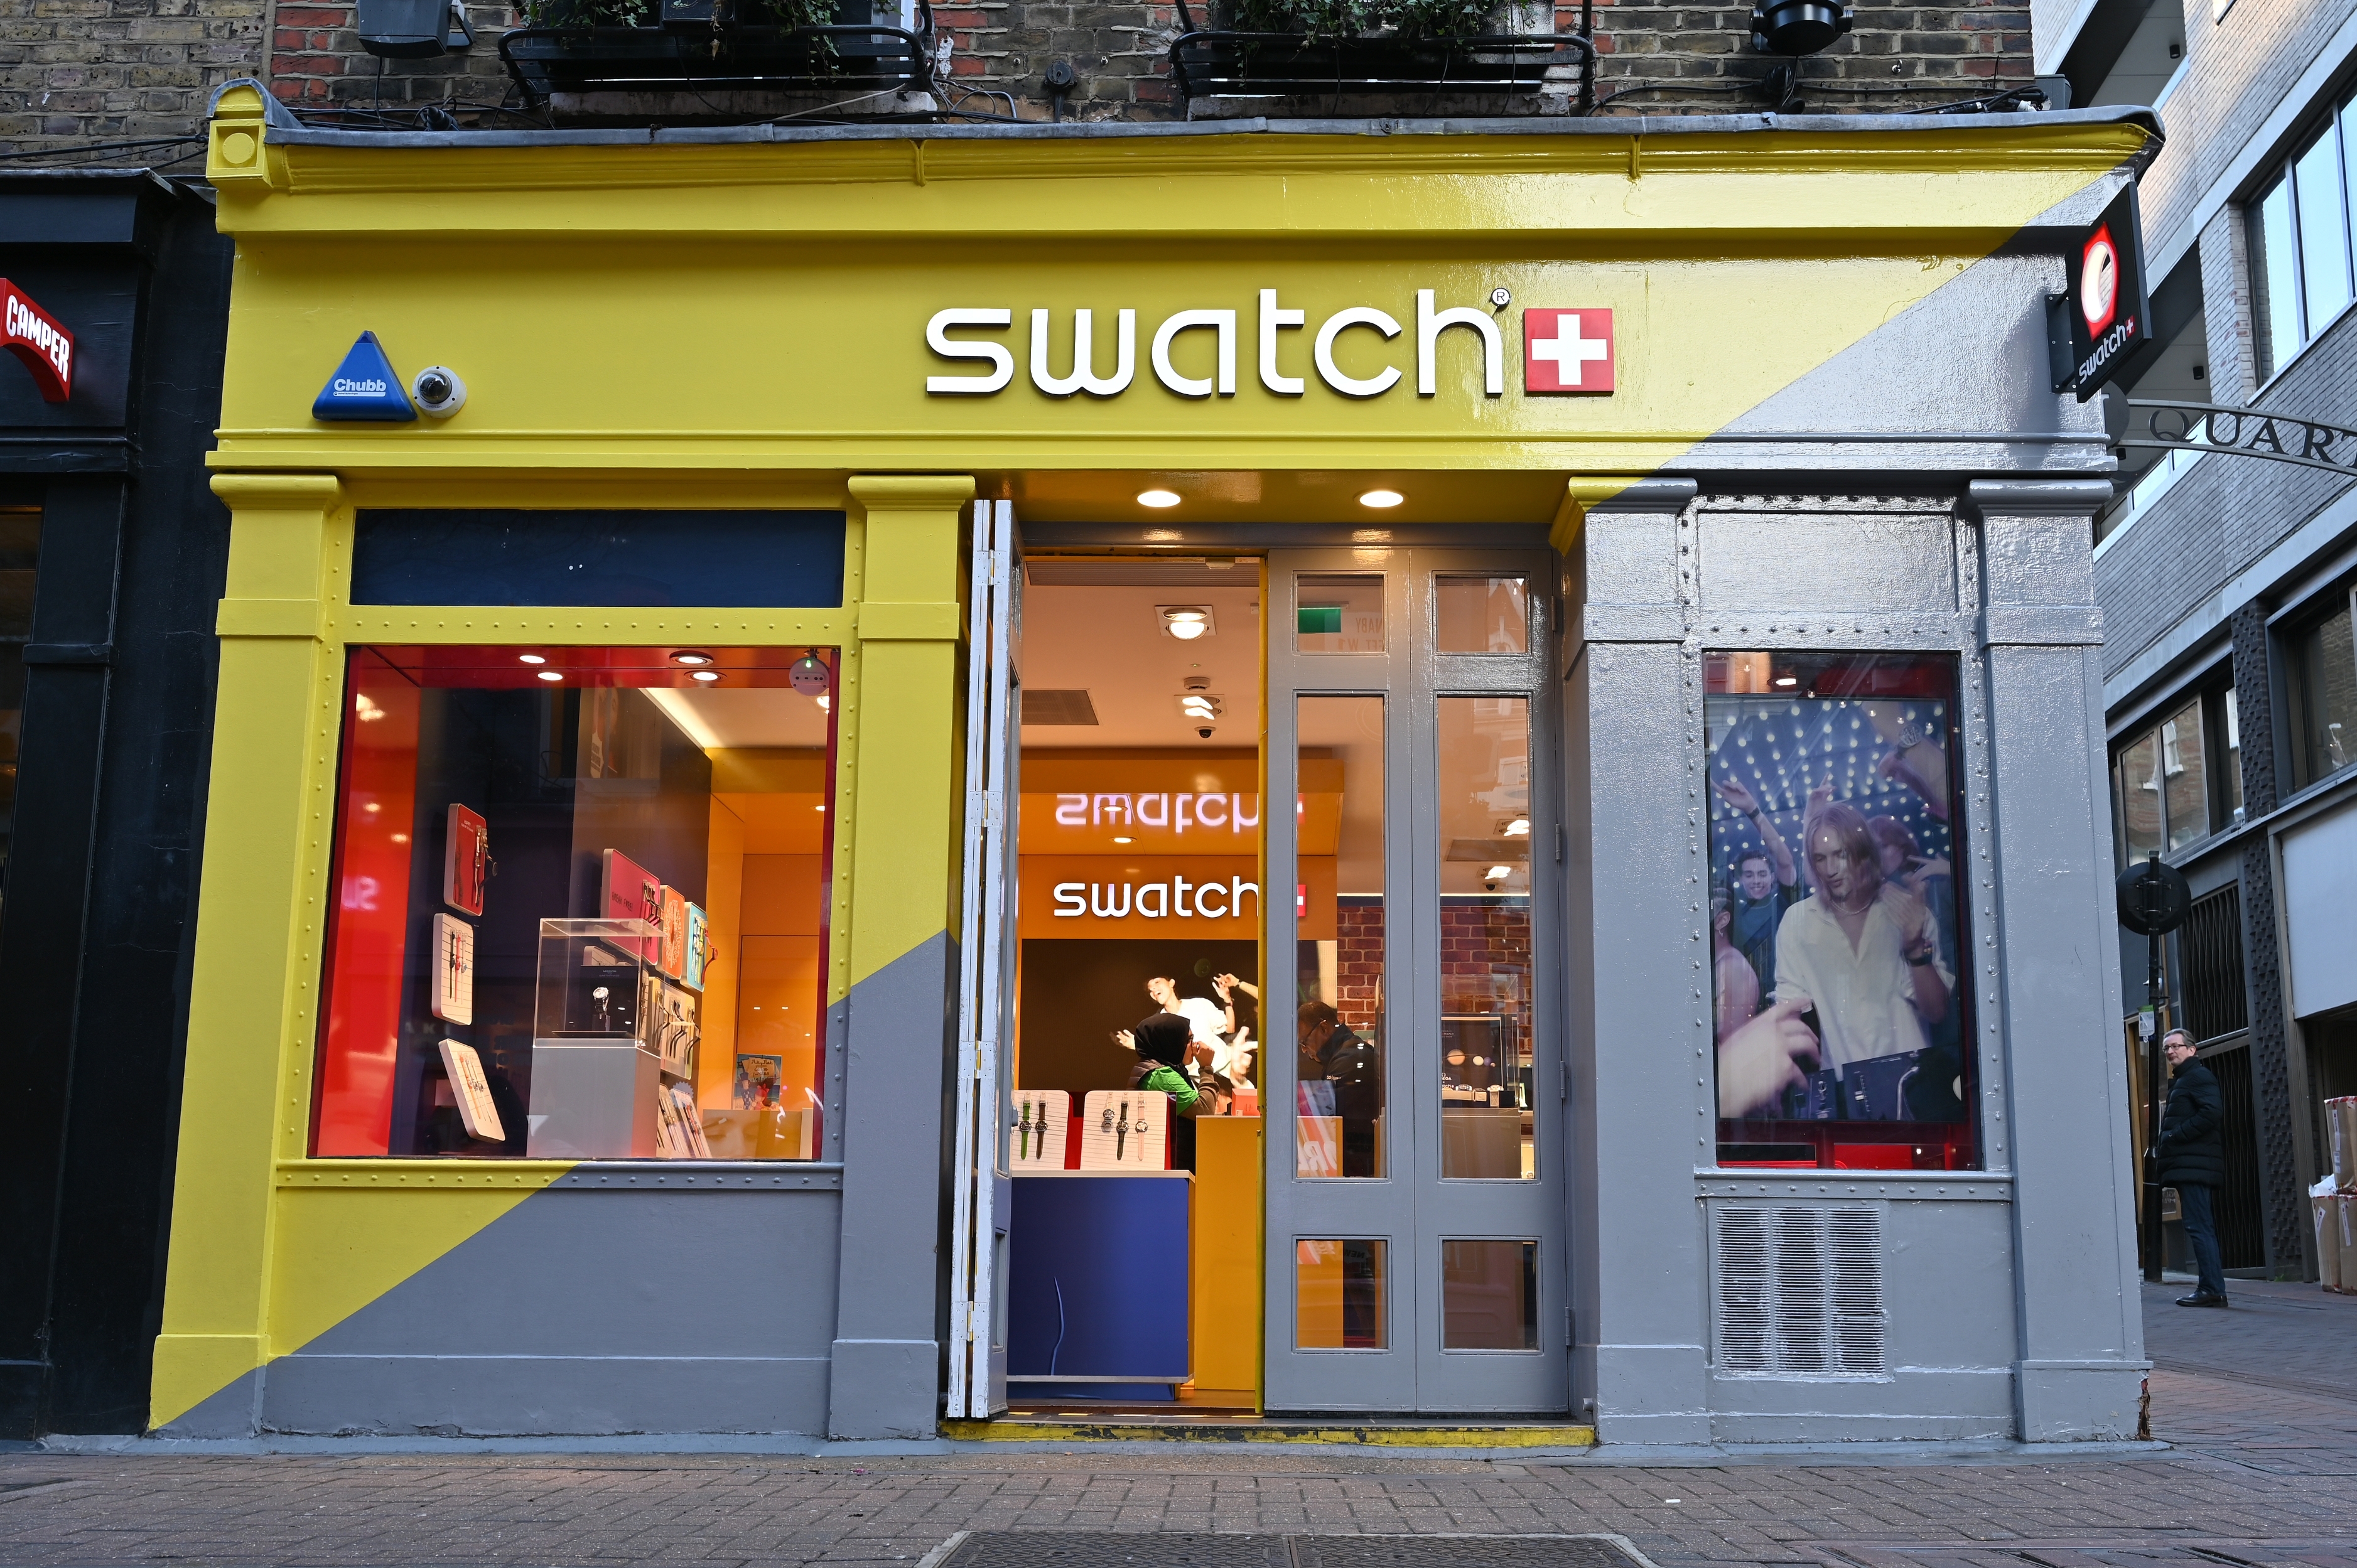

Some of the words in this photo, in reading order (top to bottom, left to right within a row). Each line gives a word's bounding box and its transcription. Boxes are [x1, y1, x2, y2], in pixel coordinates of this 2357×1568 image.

[6, 294, 72, 382] CAMPER
[926, 288, 1503, 399] swatch
[2078, 323, 2127, 386] swatch
[333, 379, 387, 392] Chubb
[1053, 875, 1259, 918] swatch
